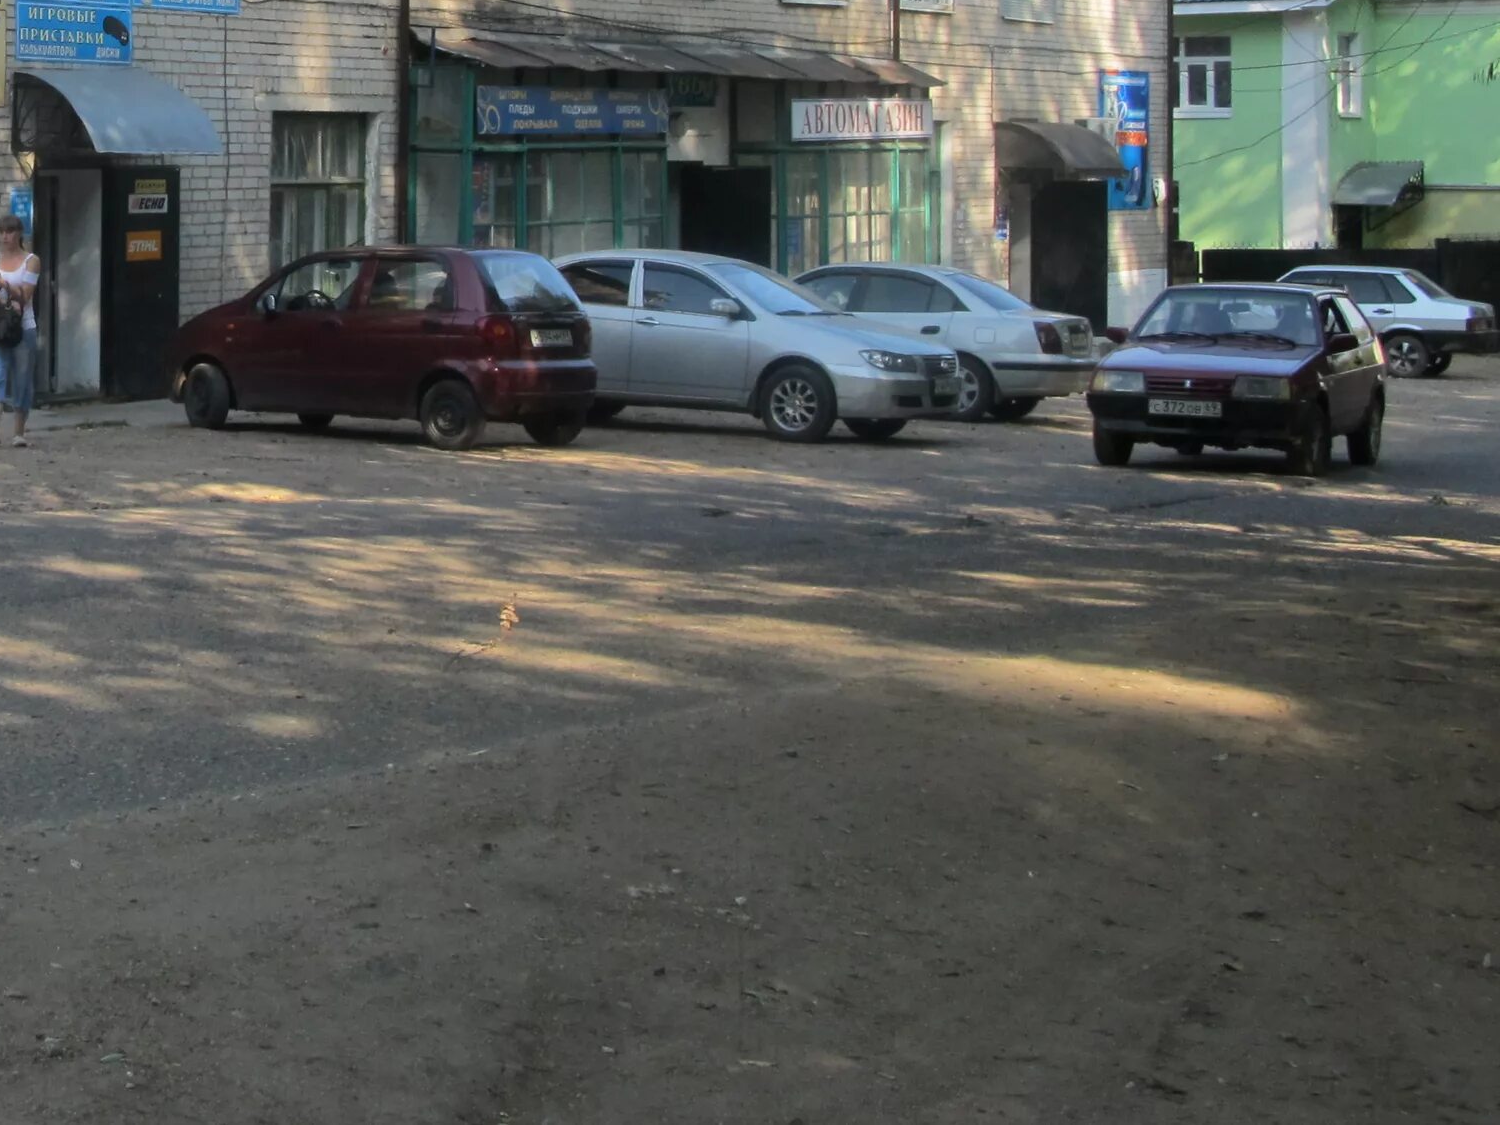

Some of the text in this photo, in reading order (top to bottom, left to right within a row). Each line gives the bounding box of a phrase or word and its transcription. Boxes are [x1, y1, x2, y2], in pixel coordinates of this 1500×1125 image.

[28, 7, 97, 23] ИГРОВЫЕ
[20, 27, 105, 45] ПРИСТАВКИ
[508, 104, 535, 115] ПЛЕДЫ
[562, 105, 598, 115] ПОДУШКИ
[801, 103, 924, 135] АВТОМАГАЗИН
[139, 197, 166, 210] ECHO
[128, 239, 158, 253] STIHL
